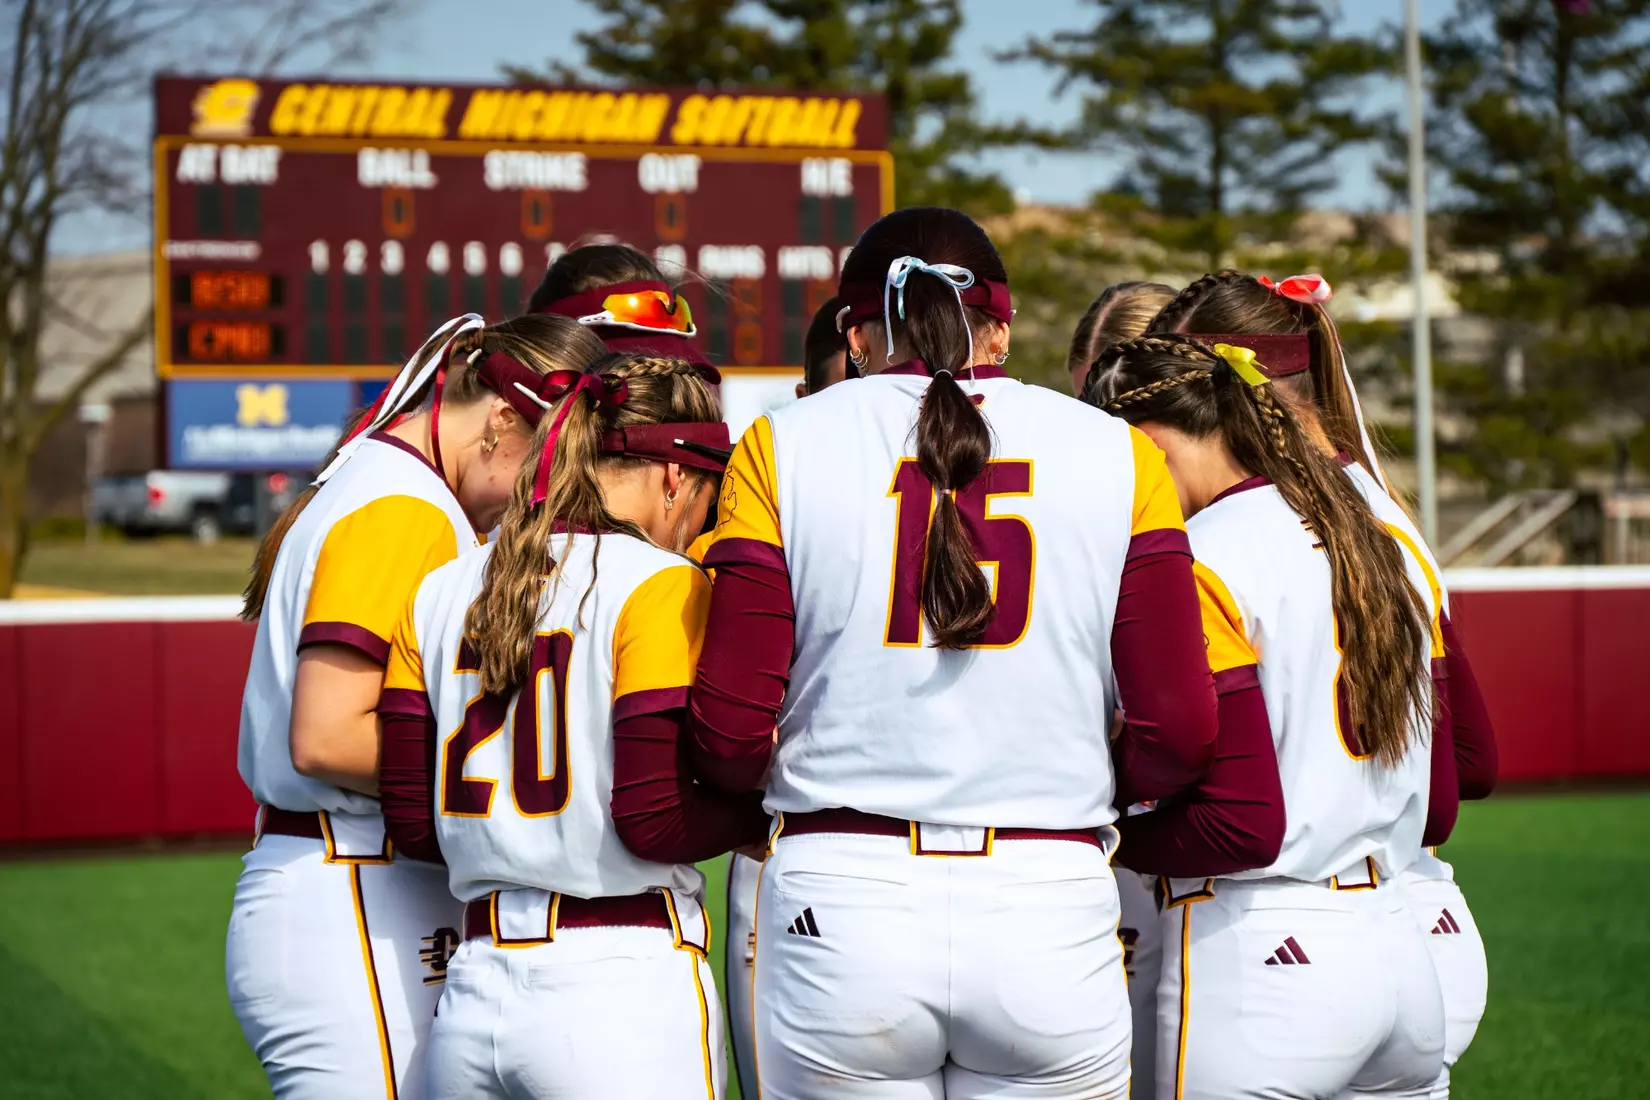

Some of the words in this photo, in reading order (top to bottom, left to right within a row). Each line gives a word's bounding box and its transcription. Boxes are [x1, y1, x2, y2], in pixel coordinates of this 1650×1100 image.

[270, 84, 450, 137] CENTRAL
[458, 89, 669, 143] MICHIGAN
[671, 95, 861, 148] SOFTBALL
[177, 145, 217, 184] AT
[220, 145, 281, 185] BAT
[357, 148, 437, 188] BALL
[484, 150, 588, 191] STRIKE
[638, 152, 701, 194] OUT
[309, 240, 329, 275] 1
[344, 240, 367, 275] 2
[380, 240, 404, 275] 3
[426, 241, 450, 275] 4
[698, 245, 765, 279] RUNS
[777, 246, 834, 280] HITS
[883, 457, 1035, 649] 15
[440, 627, 574, 818] 20
